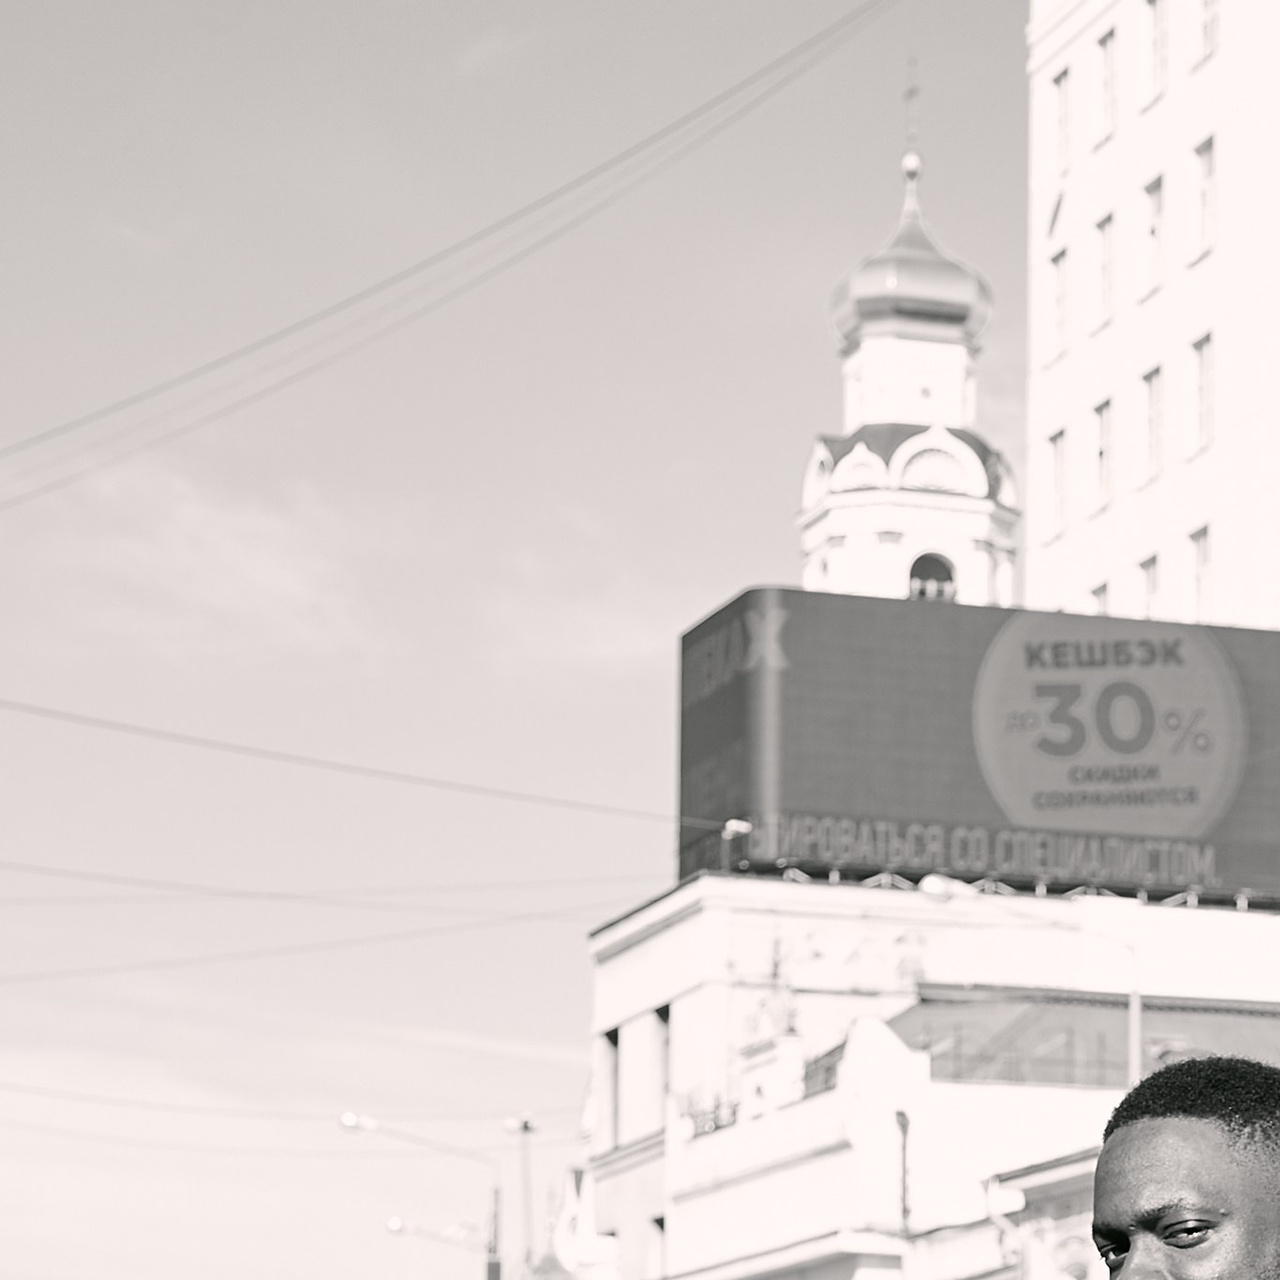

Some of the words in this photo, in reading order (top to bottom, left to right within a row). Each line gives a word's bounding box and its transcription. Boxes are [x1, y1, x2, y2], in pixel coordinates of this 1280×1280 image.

[1024, 638, 1184, 669] КЕШБЭК
[1067, 764, 1161, 784] СКИДКИ
[951, 826, 989, 873] СО
